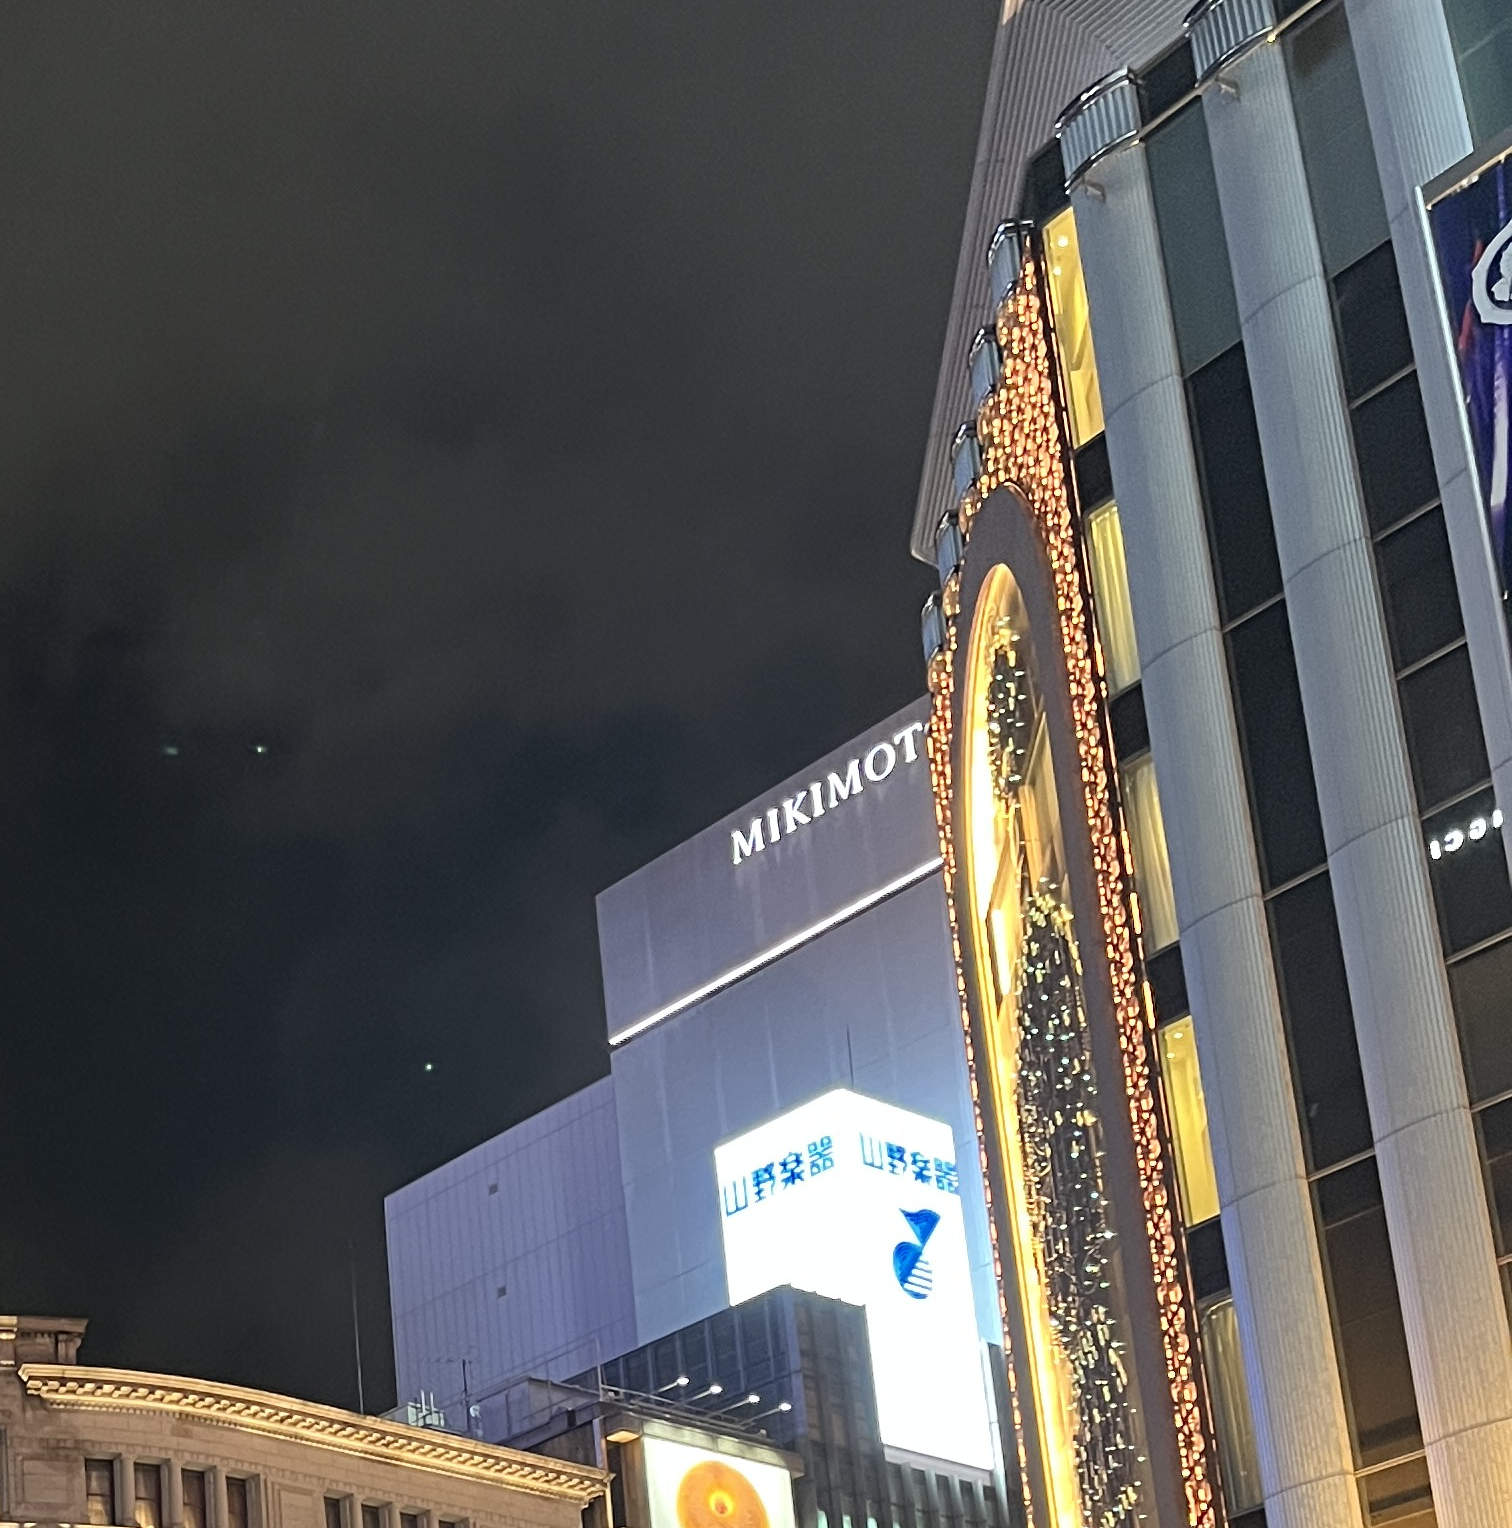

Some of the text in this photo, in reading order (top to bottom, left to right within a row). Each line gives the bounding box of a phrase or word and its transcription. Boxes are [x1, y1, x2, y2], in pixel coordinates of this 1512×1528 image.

[730, 721, 931, 866] MIKIMOT
[723, 1135, 834, 1217] 山野楽器
